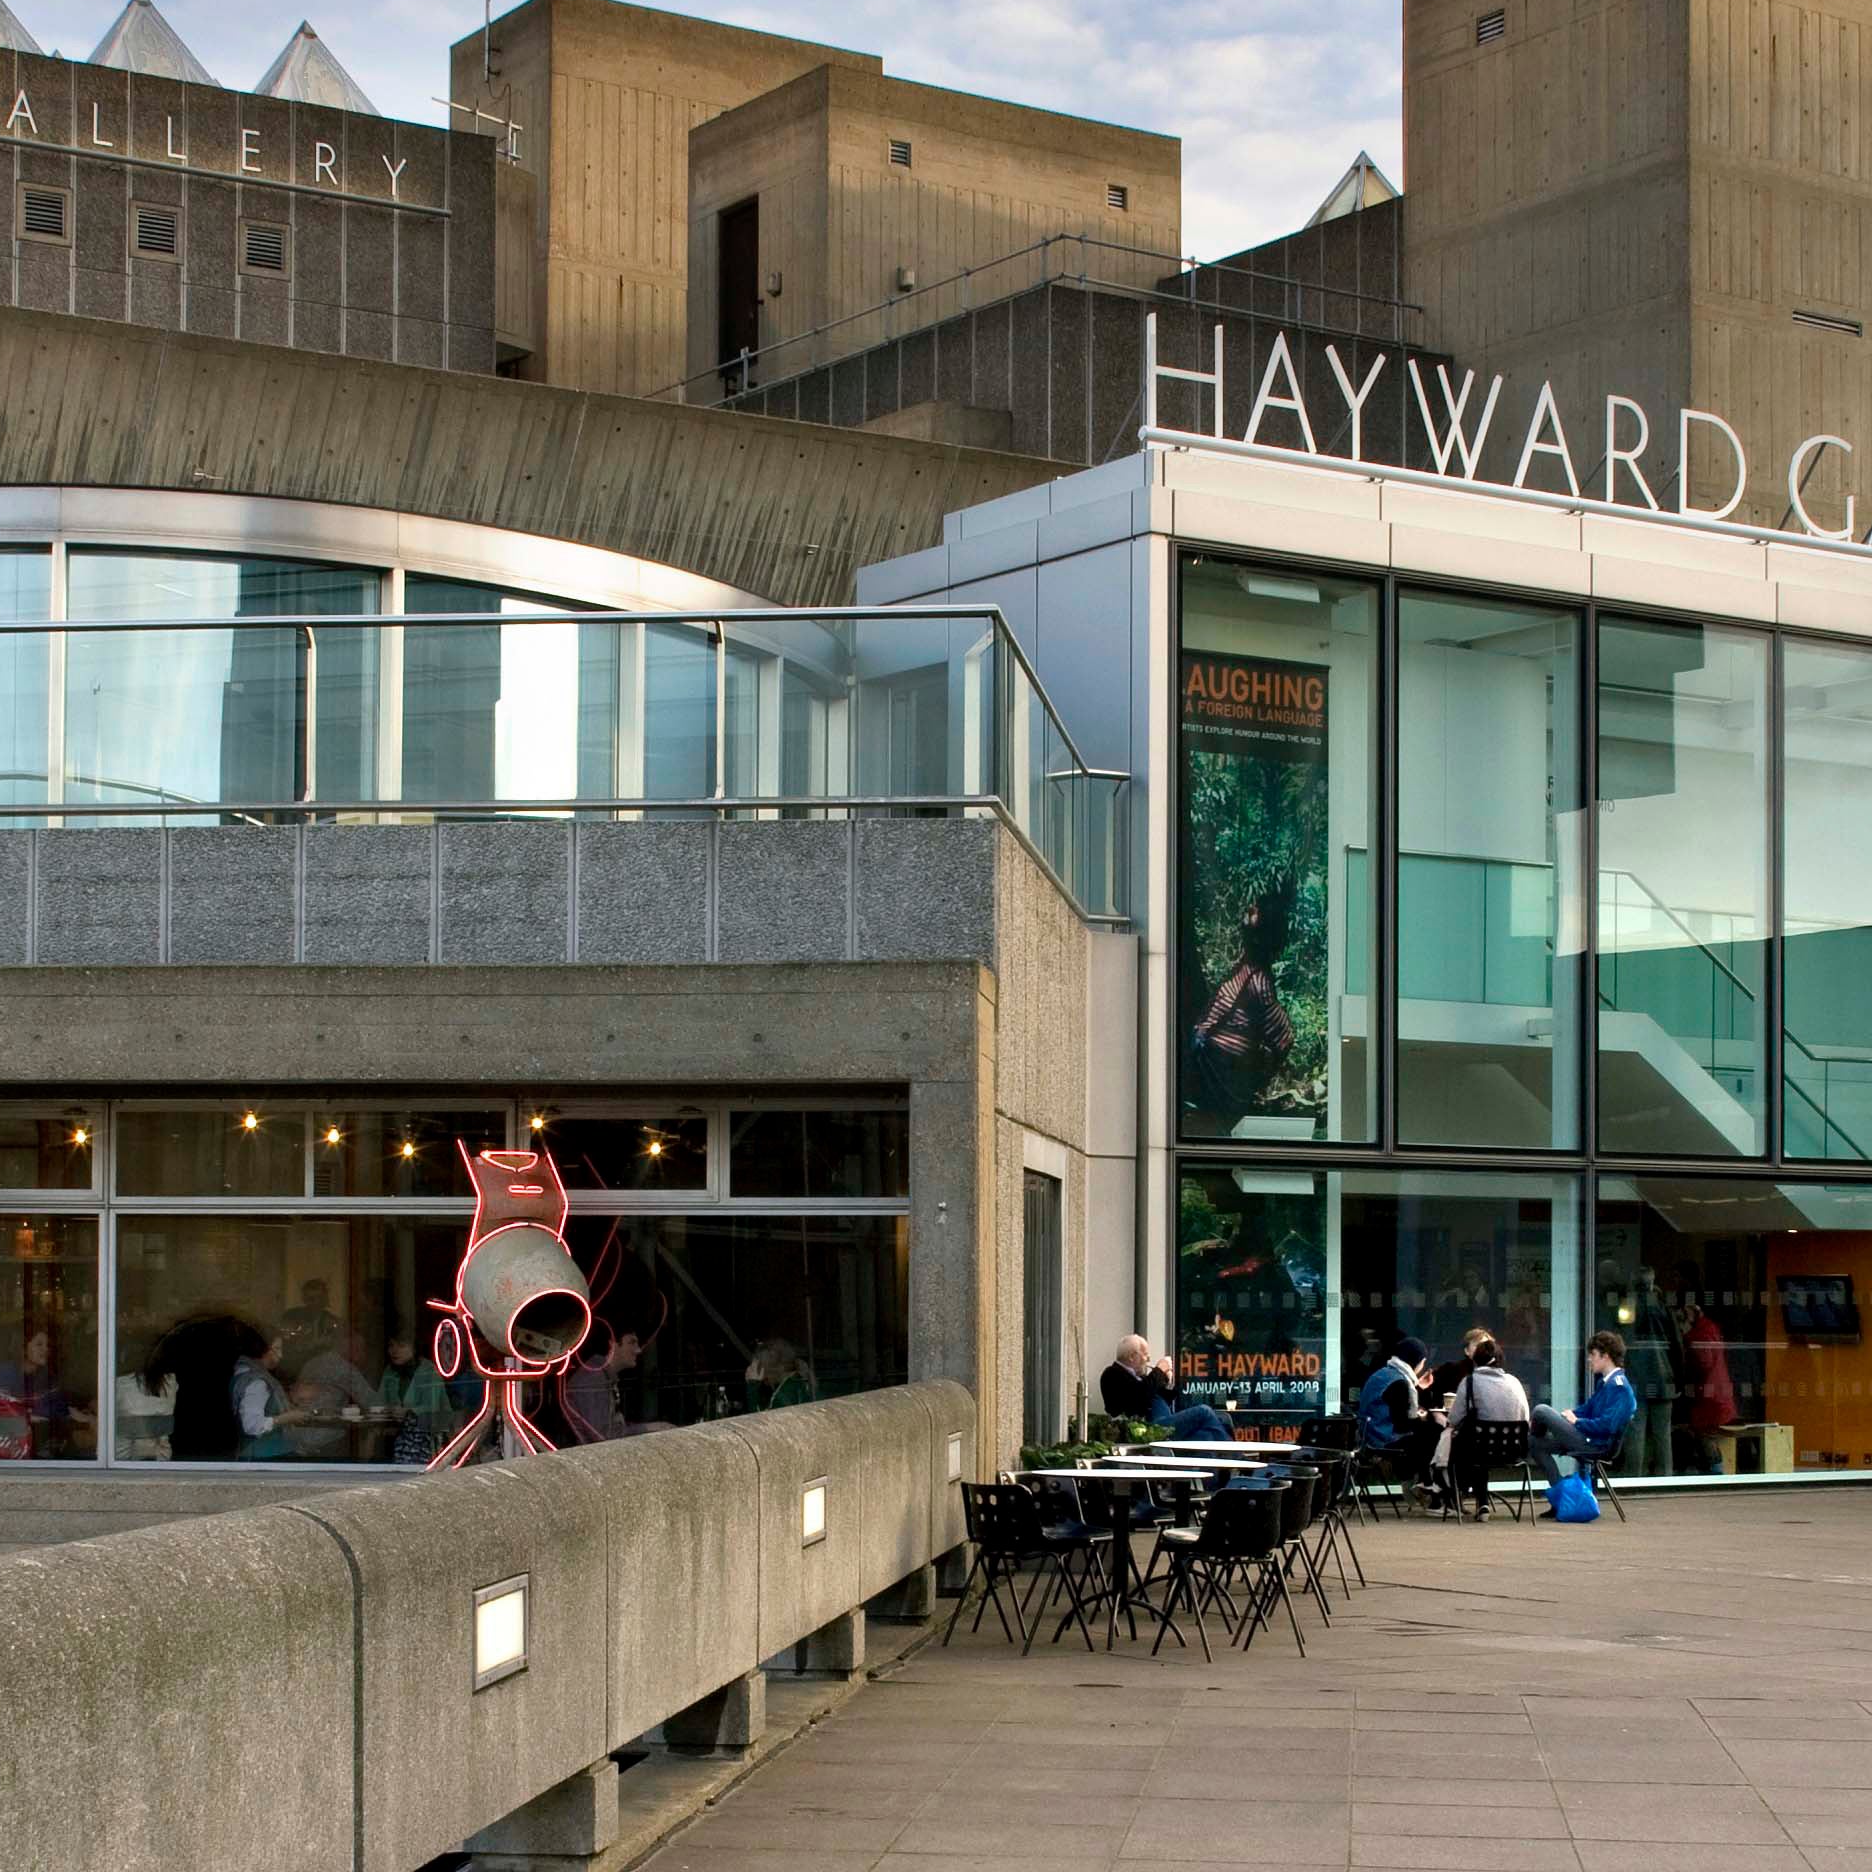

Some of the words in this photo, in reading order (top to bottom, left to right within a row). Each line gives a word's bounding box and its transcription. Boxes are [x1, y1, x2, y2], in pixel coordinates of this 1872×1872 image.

[1146, 312, 1748, 521] HAYWARD
[1183, 663, 1324, 711] AUGHING
[1198, 700, 1254, 720] FOREIGN
[1257, 708, 1324, 728] LANGUAGE
[1182, 722, 1203, 734] RTISTS
[1287, 734, 1299, 744] THE
[1179, 1353, 1209, 1377] HE
[1217, 1353, 1320, 1377] HAYWARD
[1254, 1380, 1286, 1394] APRIL
[1290, 1380, 1320, 1394] 2008
